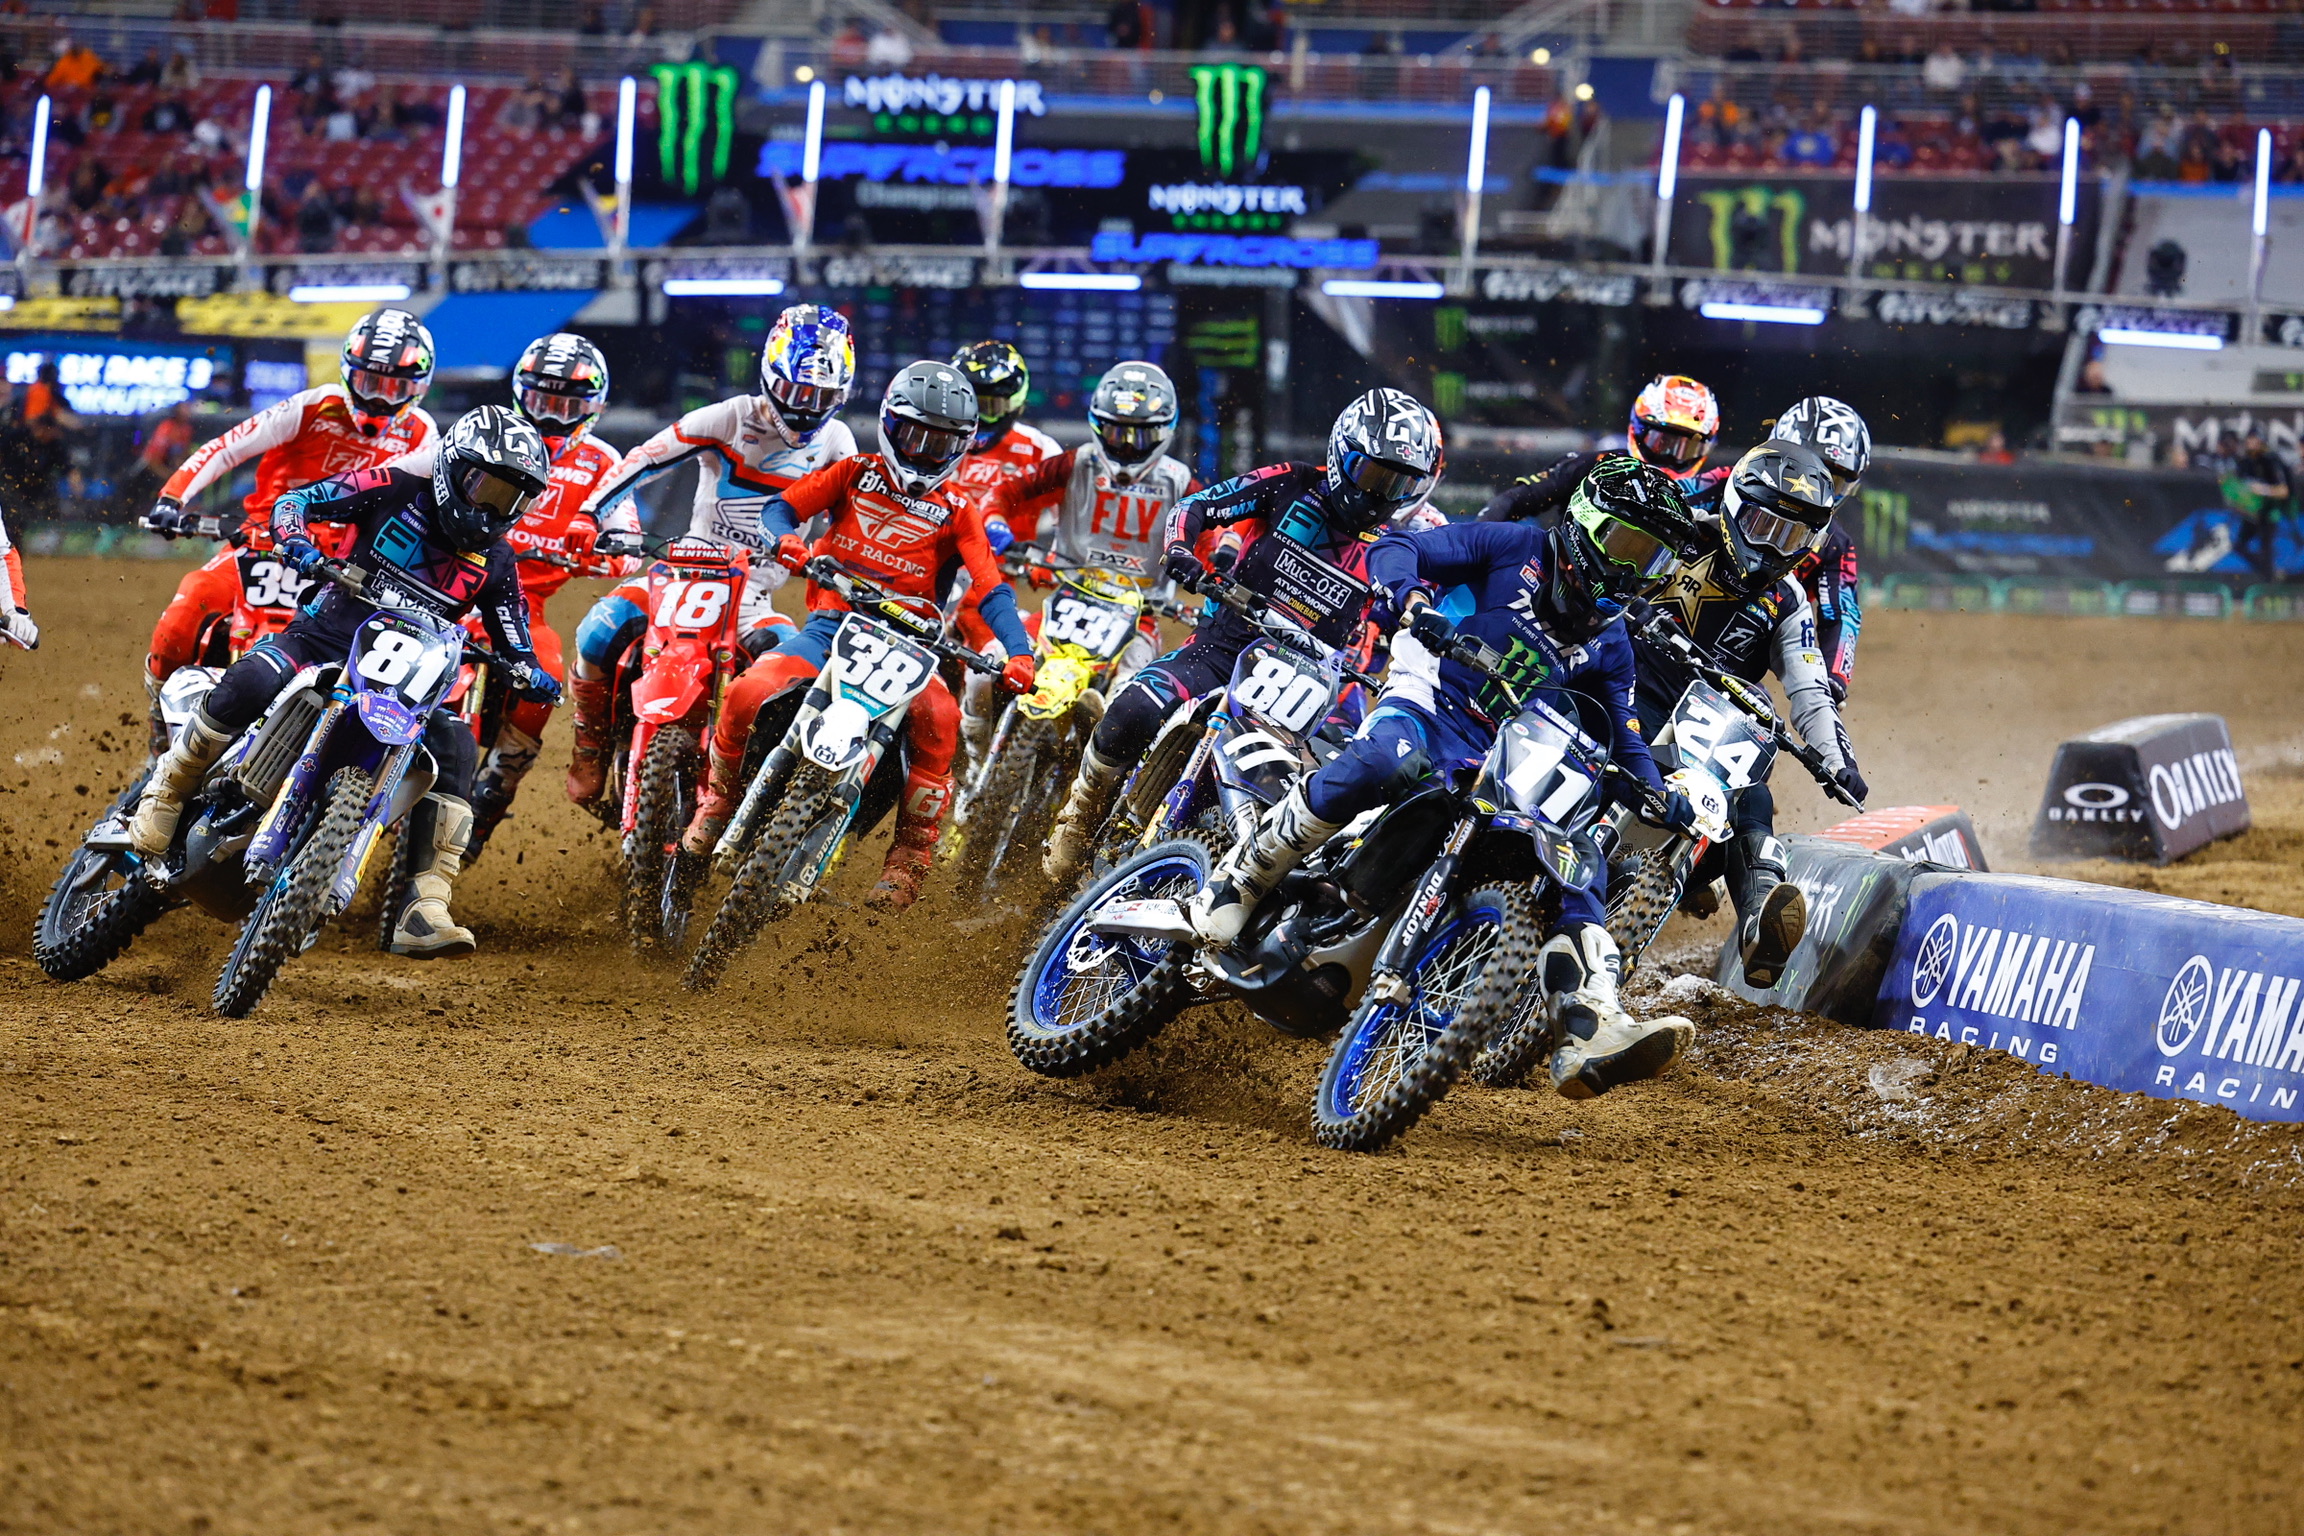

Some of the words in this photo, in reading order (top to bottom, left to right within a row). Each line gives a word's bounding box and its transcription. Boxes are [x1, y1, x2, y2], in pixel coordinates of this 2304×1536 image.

[1810, 213, 2050, 261] MONSTER
[713, 521, 764, 549] HON
[1091, 491, 1162, 543] FLY
[372, 516, 489, 603] FXR
[832, 534, 859, 551] FLY
[861, 545, 926, 578] RACING
[1278, 554, 1348, 605] Muc-Off
[246, 561, 315, 609] 39
[654, 581, 731, 628] 18
[1045, 598, 1131, 658] 331
[357, 629, 450, 704] 81
[839, 632, 924, 705] 38
[1235, 657, 1330, 732] 80
[1676, 704, 1762, 787] 24
[816, 815, 846, 863] DUNLO
[2048, 807, 2145, 823] OAKLEY
[1402, 871, 1444, 947] DUNLOP
[1947, 925, 2095, 1031] YAMAHA
[1909, 1016, 2058, 1063] RACING
[2155, 1065, 2298, 1110] RACIN
